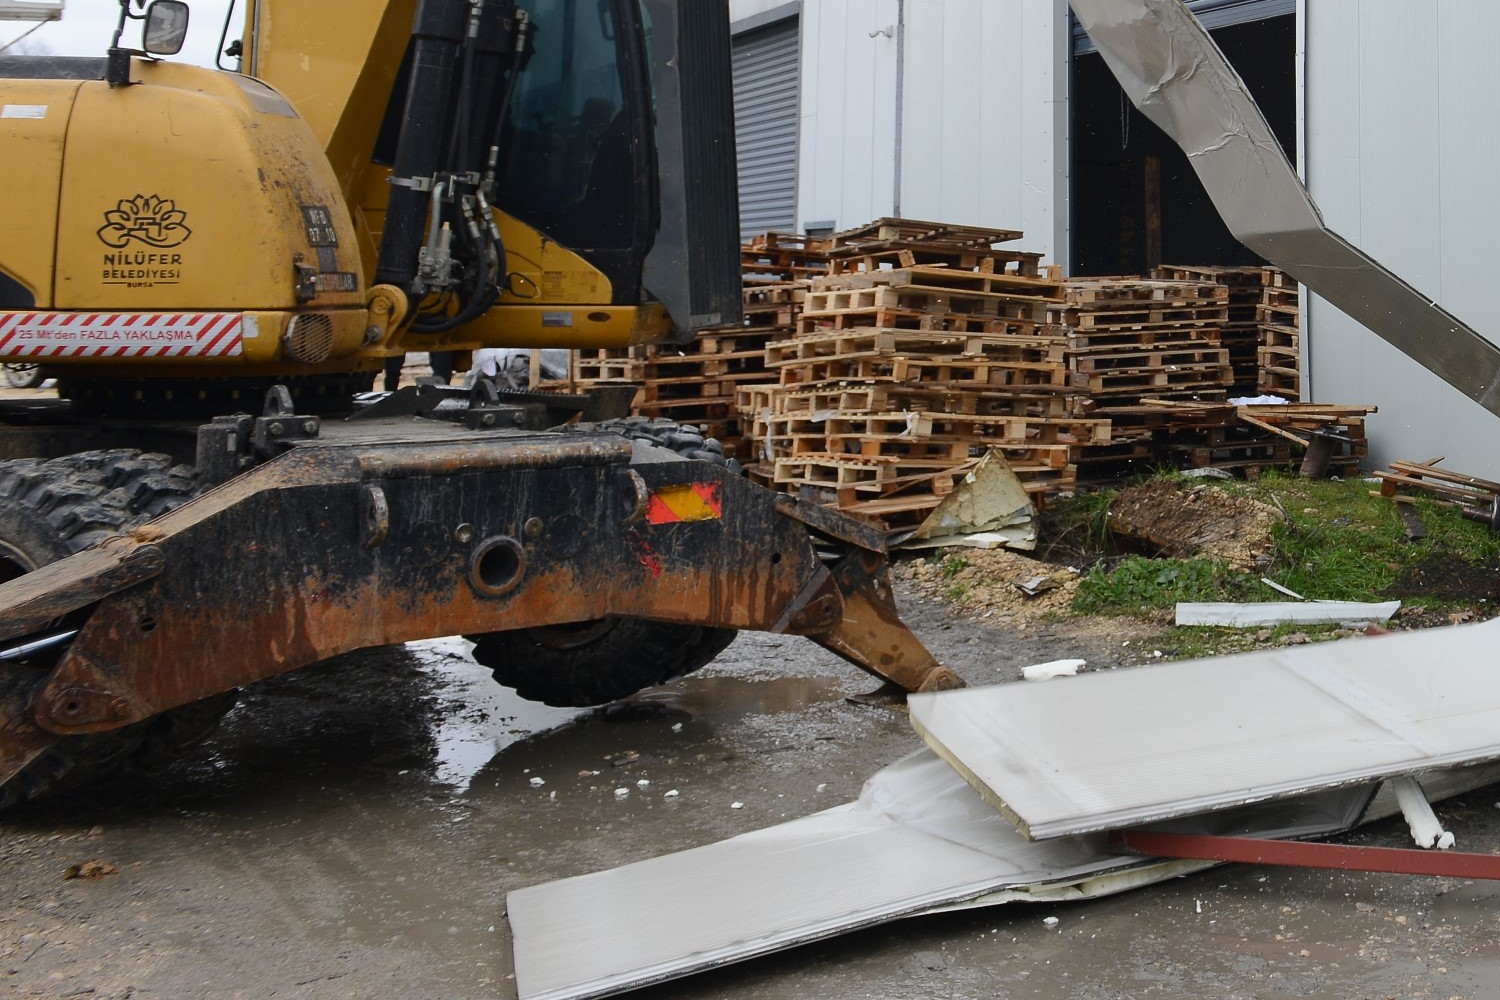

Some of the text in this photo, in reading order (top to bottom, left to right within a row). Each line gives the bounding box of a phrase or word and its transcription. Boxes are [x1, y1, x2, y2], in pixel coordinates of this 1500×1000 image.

[104, 251, 182, 265] NİLÜFER
[103, 269, 180, 279] BELEDİYESİ
[18, 329, 193, 342] 25 Mt'den FAZLA YAKLAŞMA
